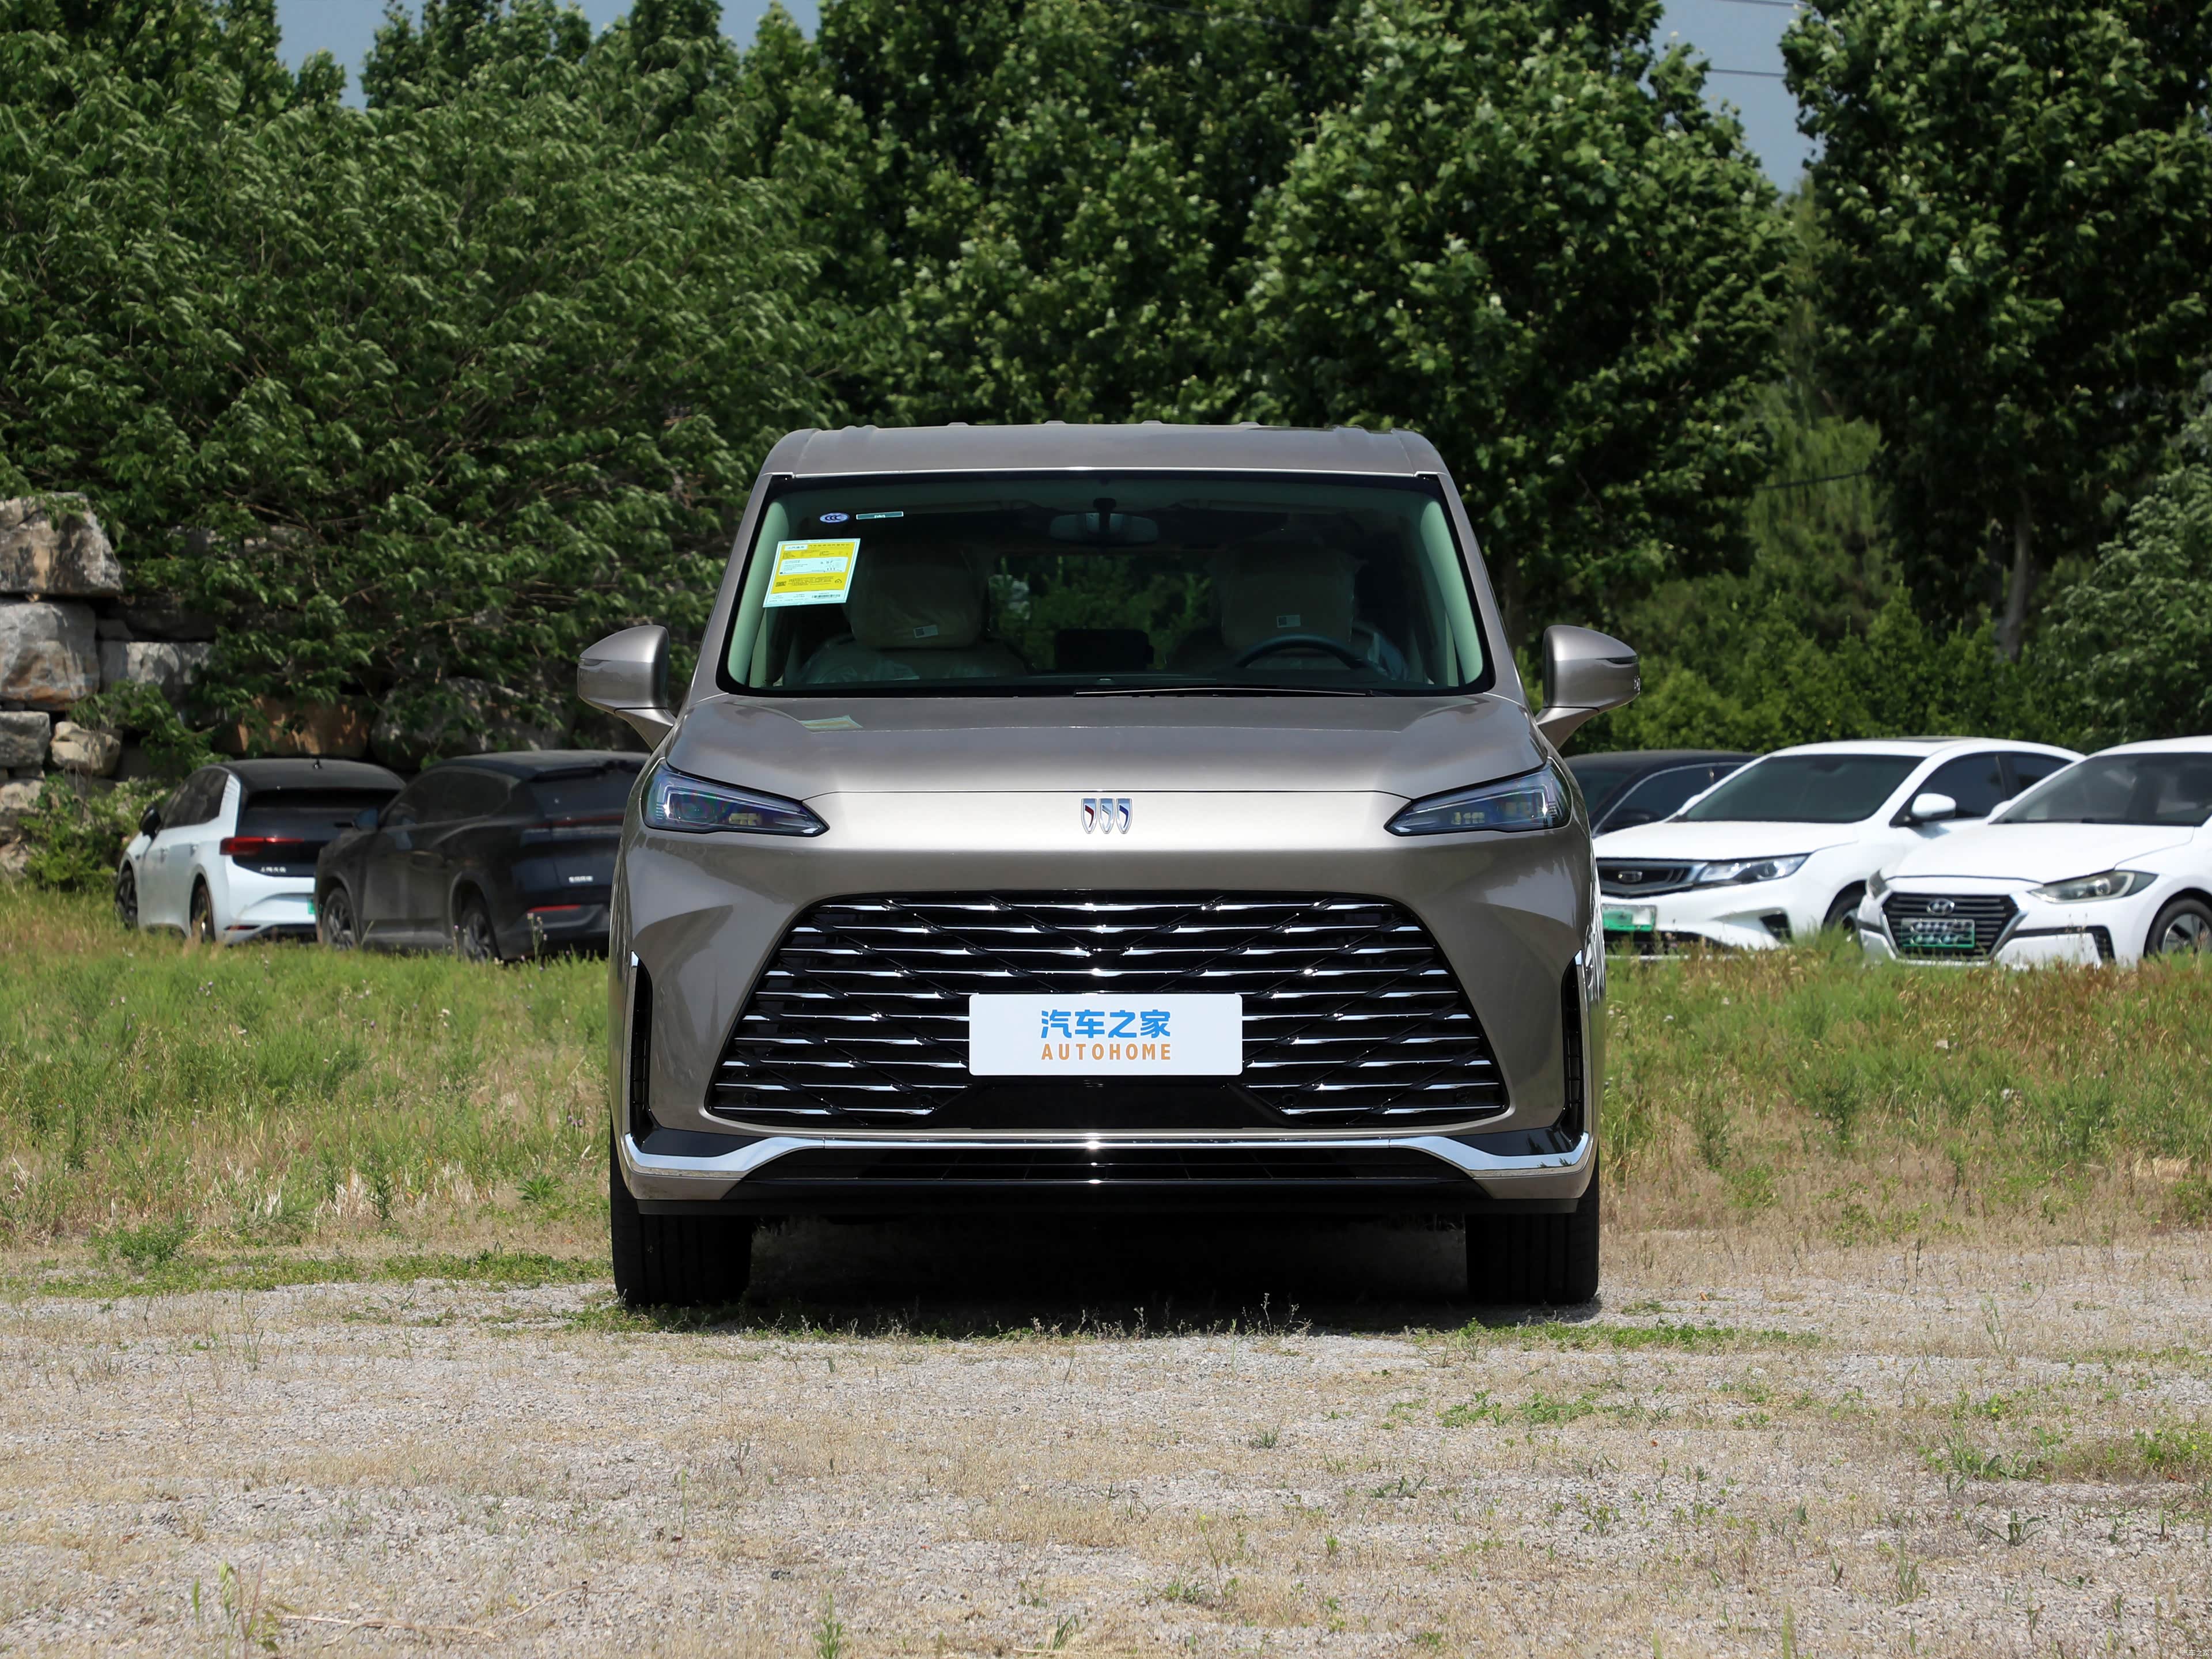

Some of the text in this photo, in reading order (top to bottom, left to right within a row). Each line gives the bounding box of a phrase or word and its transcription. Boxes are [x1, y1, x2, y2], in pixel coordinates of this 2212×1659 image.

[1041, 1009, 1171, 1039] 汽车之家
[1041, 1044, 1171, 1060] AUTOHOME
